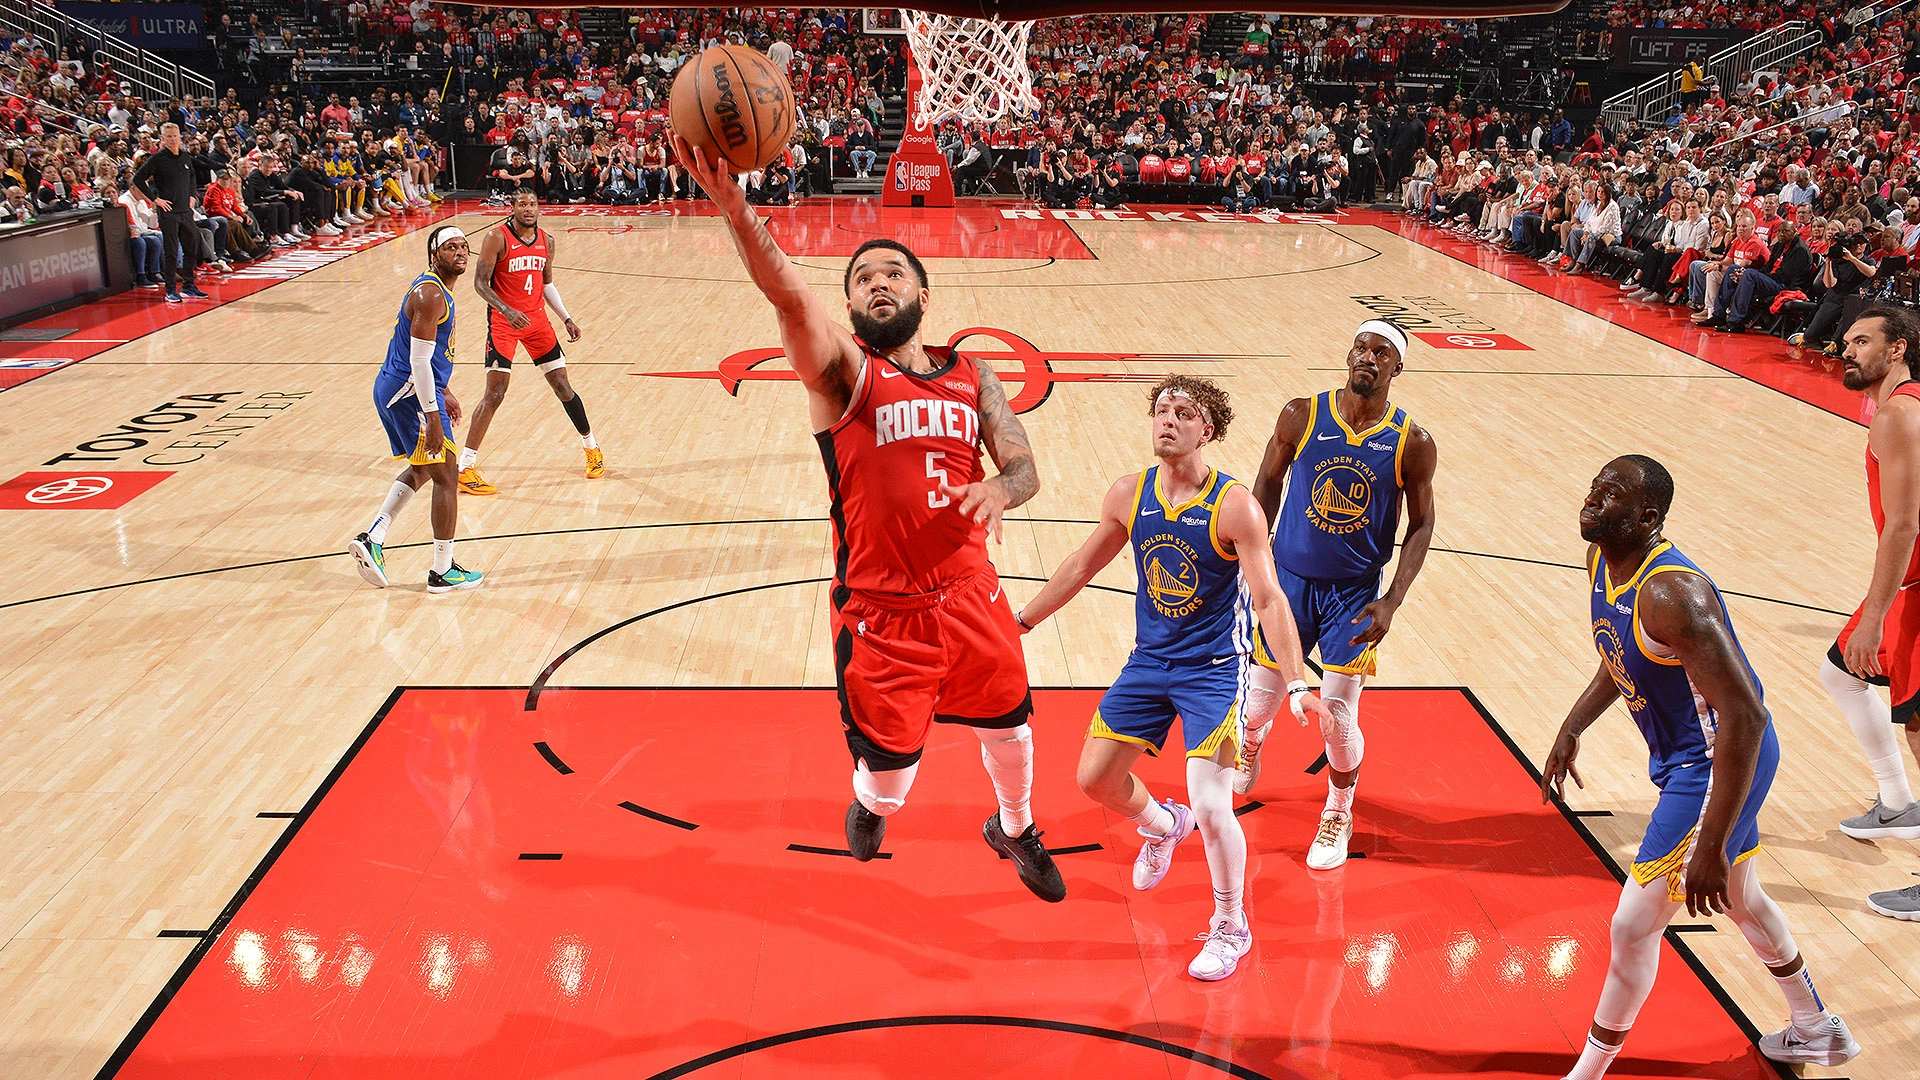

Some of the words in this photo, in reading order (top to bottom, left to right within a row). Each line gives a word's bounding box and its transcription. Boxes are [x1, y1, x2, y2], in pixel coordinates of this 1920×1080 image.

[143, 19, 199, 34] ULTRA
[1639, 41, 1707, 58] LIFTOFF
[711, 62, 748, 150] Wilson
[906, 134, 933, 145] Google
[910, 162, 940, 179] League
[910, 177, 931, 191] Pass
[1000, 209, 1338, 225] ROCKETS
[0, 262, 26, 292] AN
[29, 245, 97, 283] EXPRESS
[508, 256, 547, 273] ROCKETS
[523, 274, 533, 295] 4
[41, 391, 245, 466] TOYOTA
[143, 390, 314, 465] CENTER
[1367, 441, 1393, 452] Rakuten
[1314, 456, 1353, 472] GOLDEN
[1355, 459, 1377, 482] STATE
[925, 451, 950, 509] 5
[1348, 482, 1365, 499] 10
[1181, 516, 1207, 526] Rakuten
[1305, 505, 1370, 535] WARRIORS
[1140, 533, 1174, 552] GOLDEN
[1175, 537, 1199, 561] STATE
[1179, 562, 1190, 579] 2
[1146, 586, 1204, 619] WARRIORS
